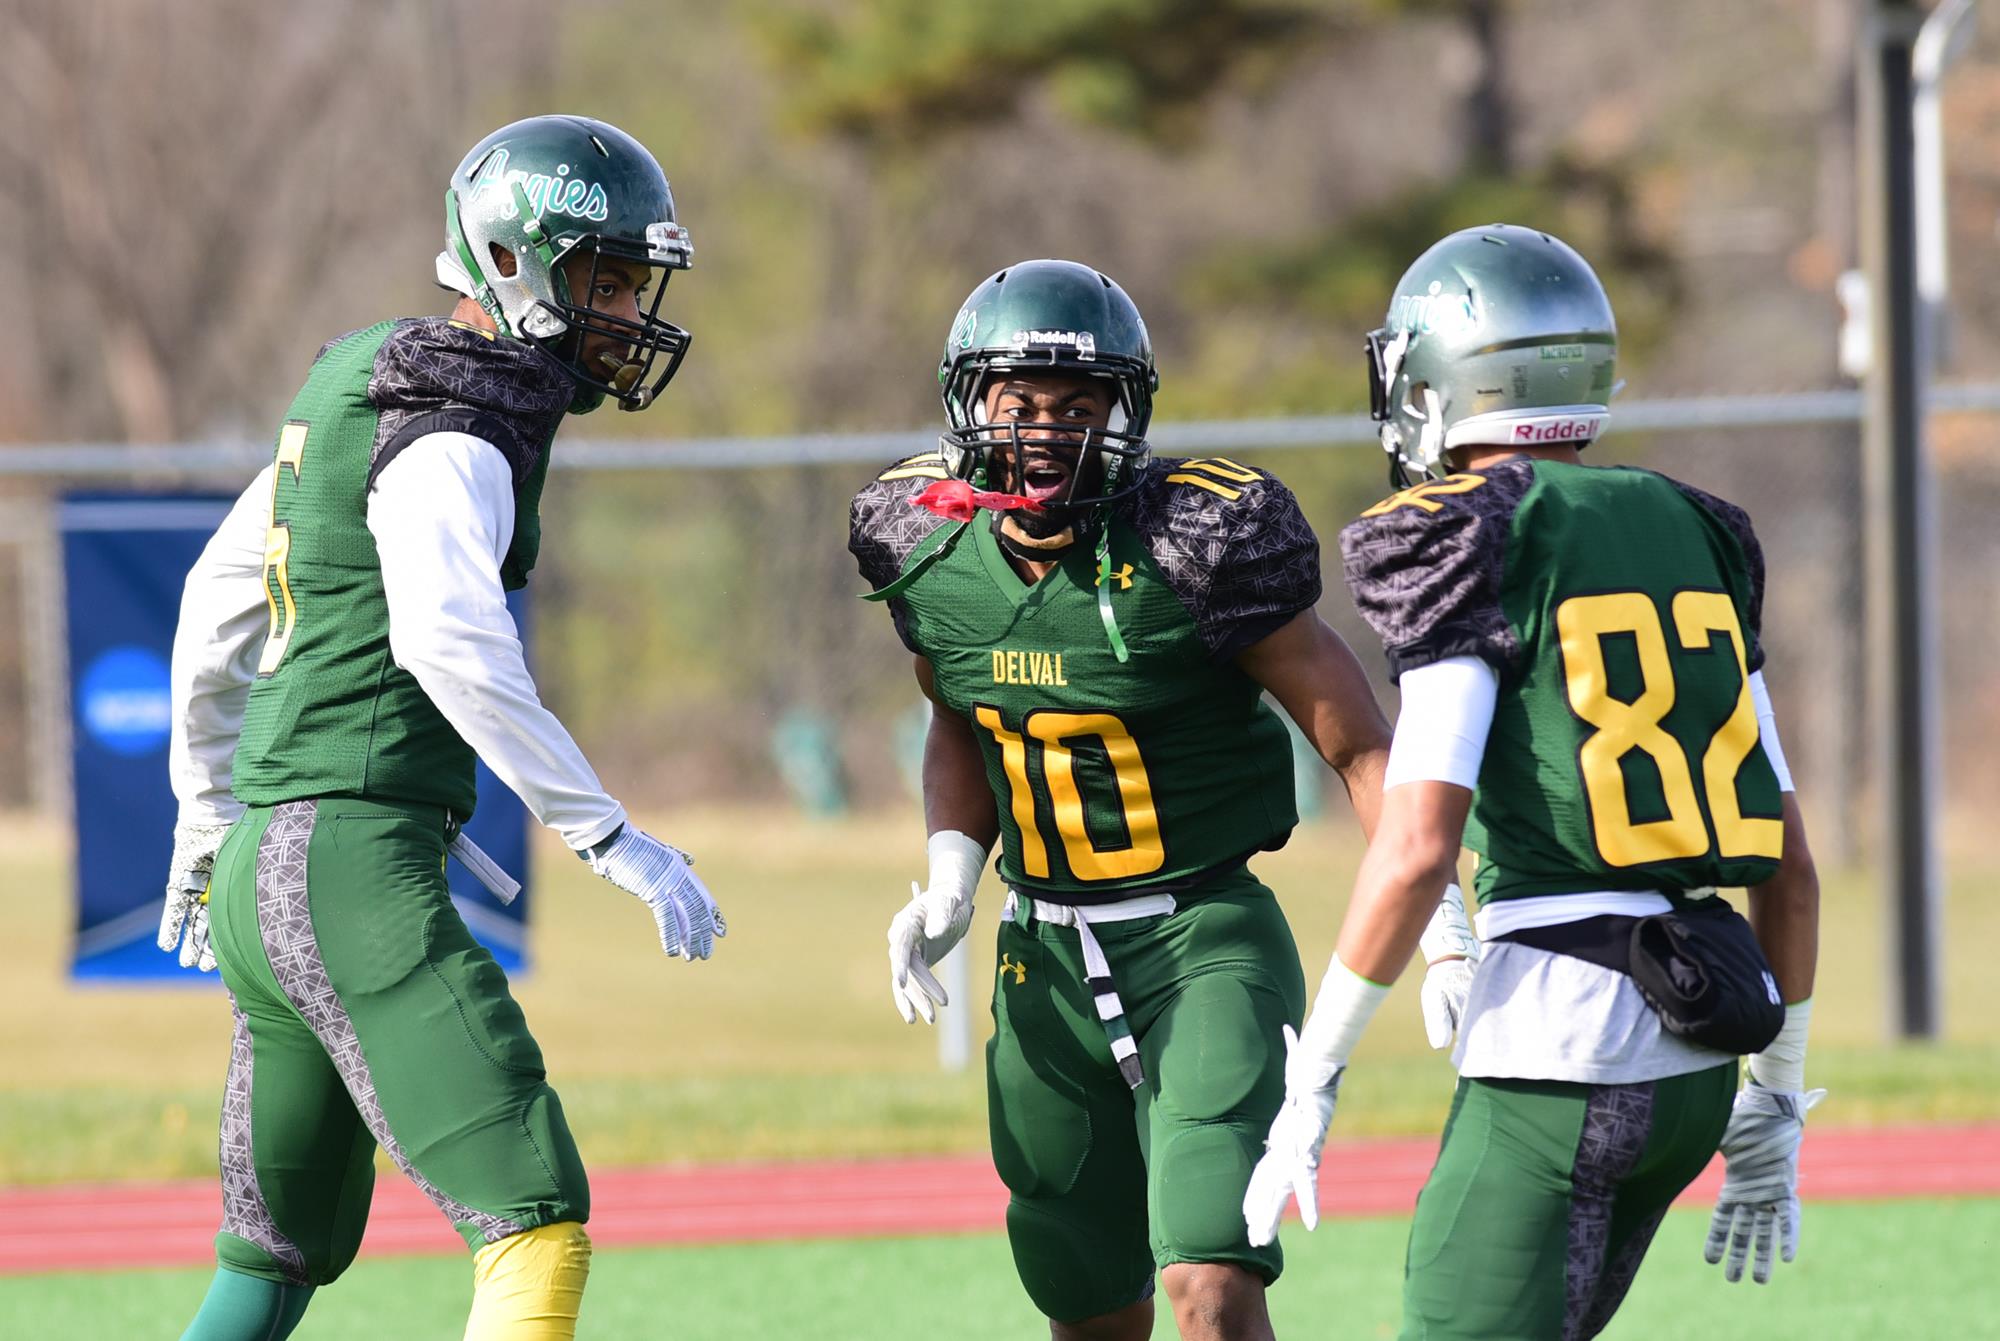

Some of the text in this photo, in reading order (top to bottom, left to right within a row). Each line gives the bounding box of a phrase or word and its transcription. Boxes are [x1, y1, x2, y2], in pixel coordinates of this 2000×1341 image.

[1029, 330, 1077, 345] Riddell
[1515, 418, 1601, 441] Riddell
[1165, 457, 1265, 501] 10
[992, 650, 1068, 686] DELVAL
[1556, 590, 1784, 868] 82
[972, 703, 1167, 882] 10
